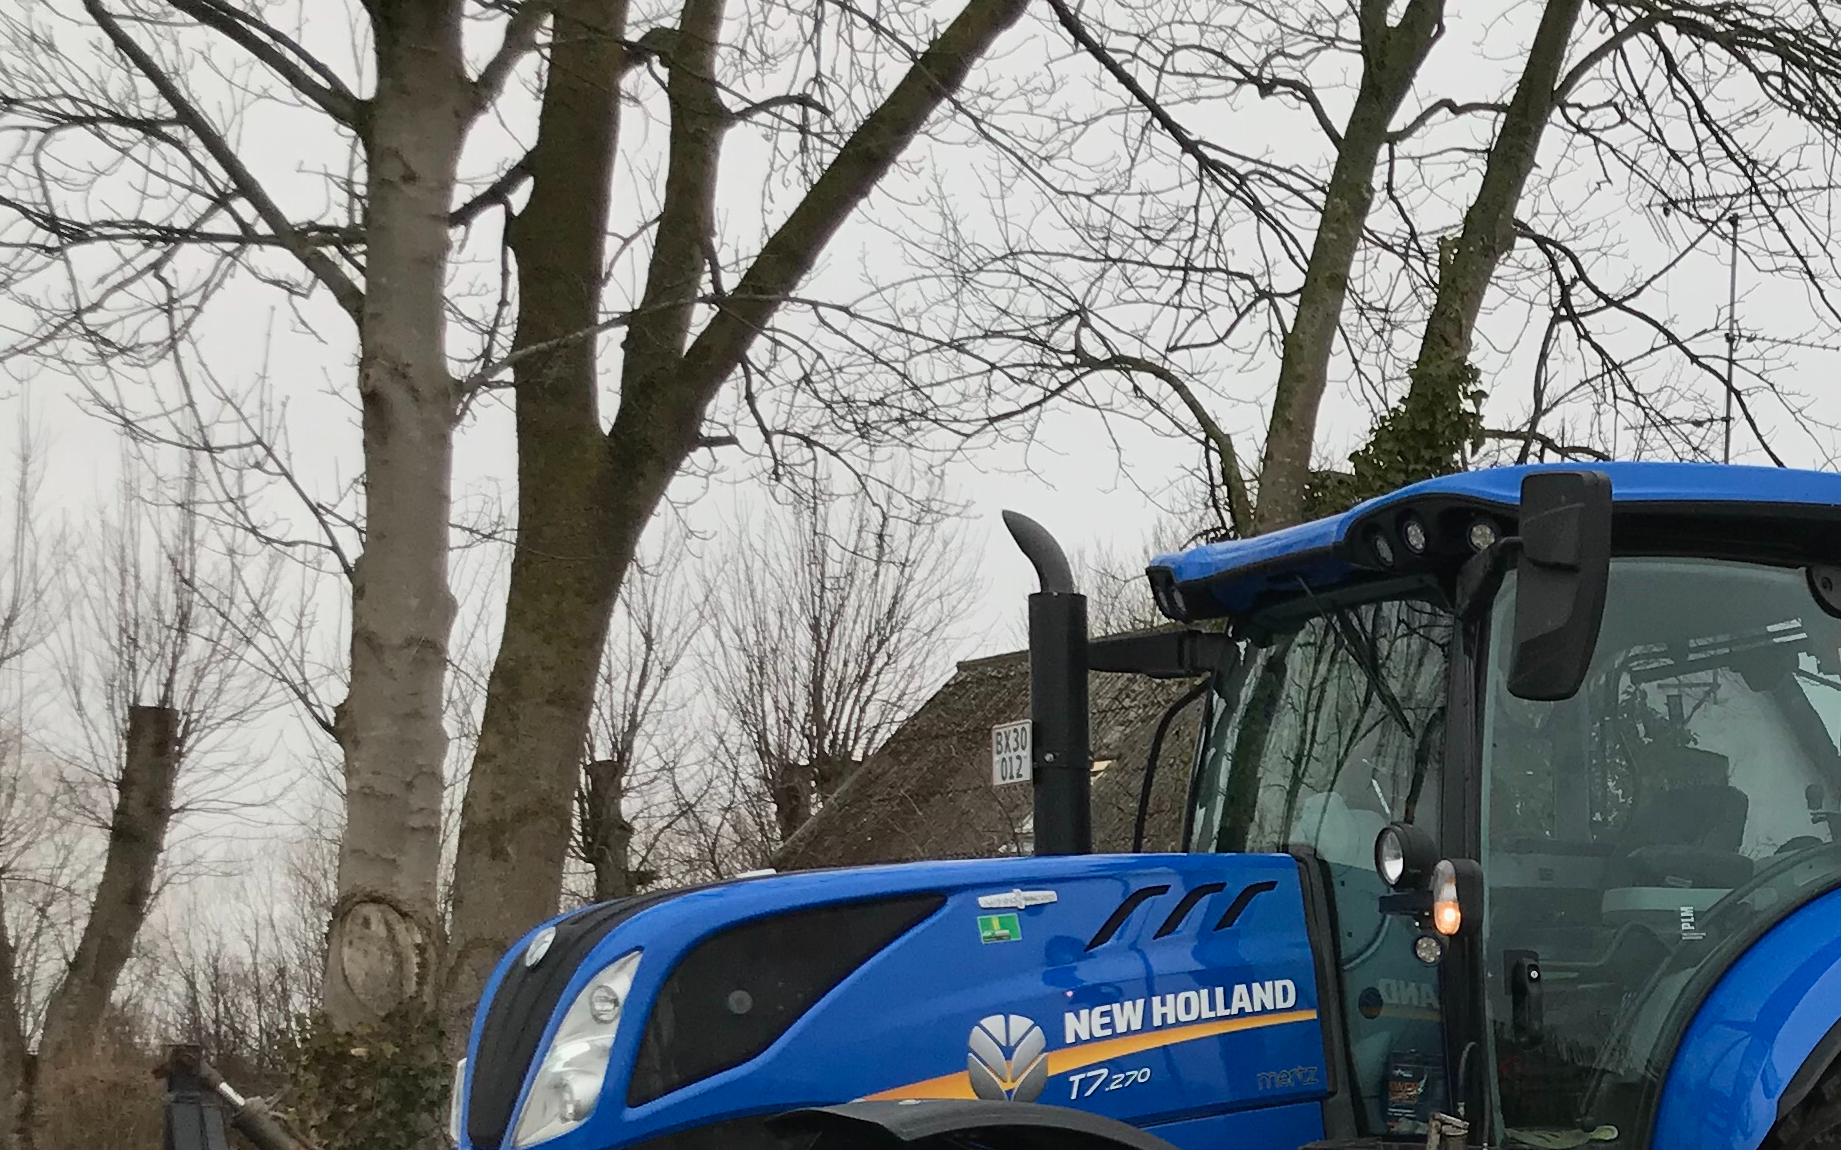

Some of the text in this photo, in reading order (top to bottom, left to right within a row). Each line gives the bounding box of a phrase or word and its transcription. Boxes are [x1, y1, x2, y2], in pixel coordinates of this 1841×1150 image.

[996, 726, 1028, 755] BX30
[1001, 754, 1023, 781] 012
[1064, 979, 1296, 1044] NEW HOLLAND
[1068, 1067, 1151, 1100] T7.270
